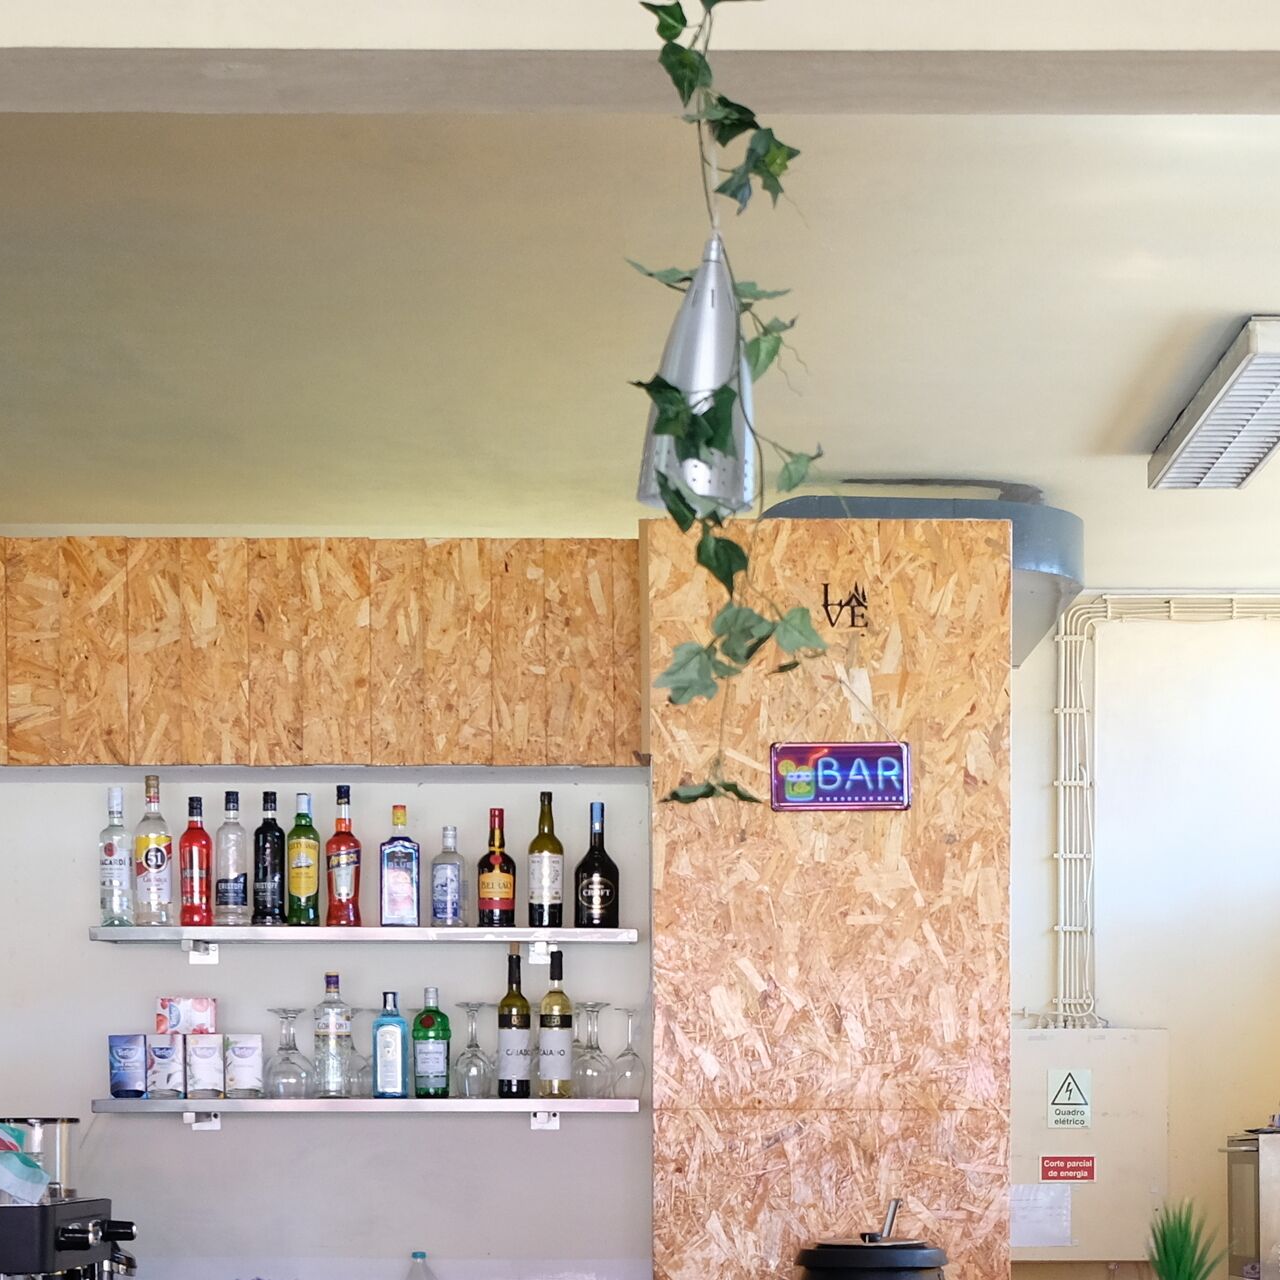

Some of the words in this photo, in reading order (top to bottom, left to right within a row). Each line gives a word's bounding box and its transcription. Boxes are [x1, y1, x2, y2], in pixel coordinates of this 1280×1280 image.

[817, 756, 902, 791] BAR
[147, 852, 163, 865] 51
[1054, 1108, 1085, 1116] Quadro
[1054, 1117, 1085, 1126] elétrico
[1043, 1160, 1065, 1168] Corte
[1067, 1159, 1093, 1169] parcial
[1048, 1169, 1058, 1178] de
[1059, 1169, 1088, 1179] energia
